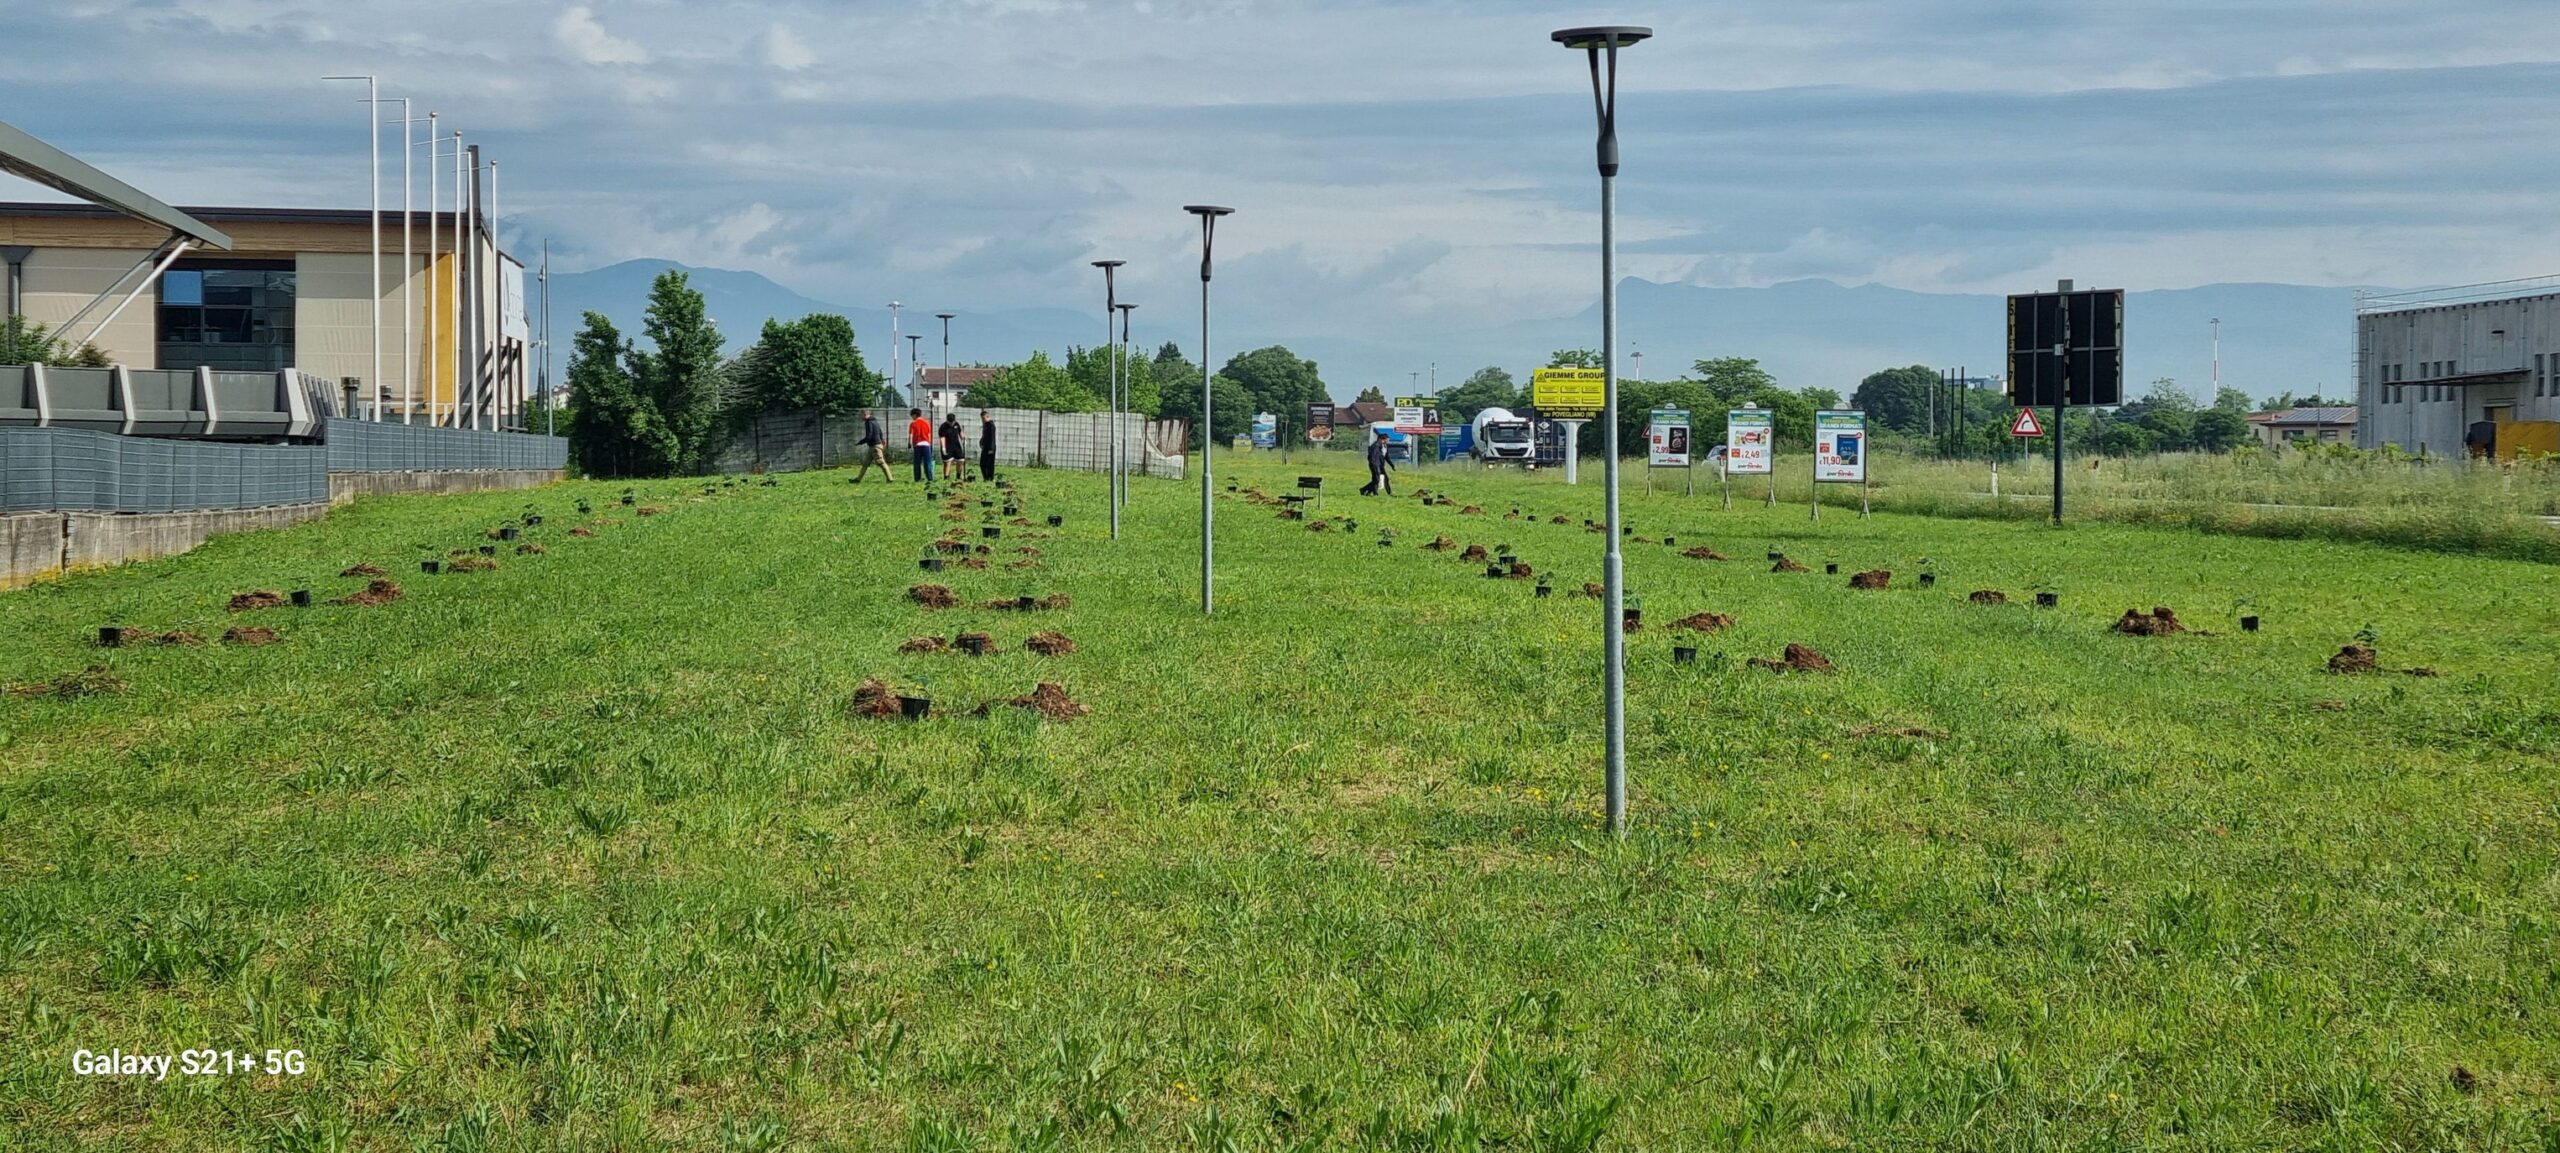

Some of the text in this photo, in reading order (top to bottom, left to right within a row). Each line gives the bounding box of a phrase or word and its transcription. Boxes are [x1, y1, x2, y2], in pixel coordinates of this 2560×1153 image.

[1544, 371, 1606, 379] GIEMME GROUP
[1745, 450, 1760, 459] 2,49
[1823, 456, 1841, 466] 11,90
